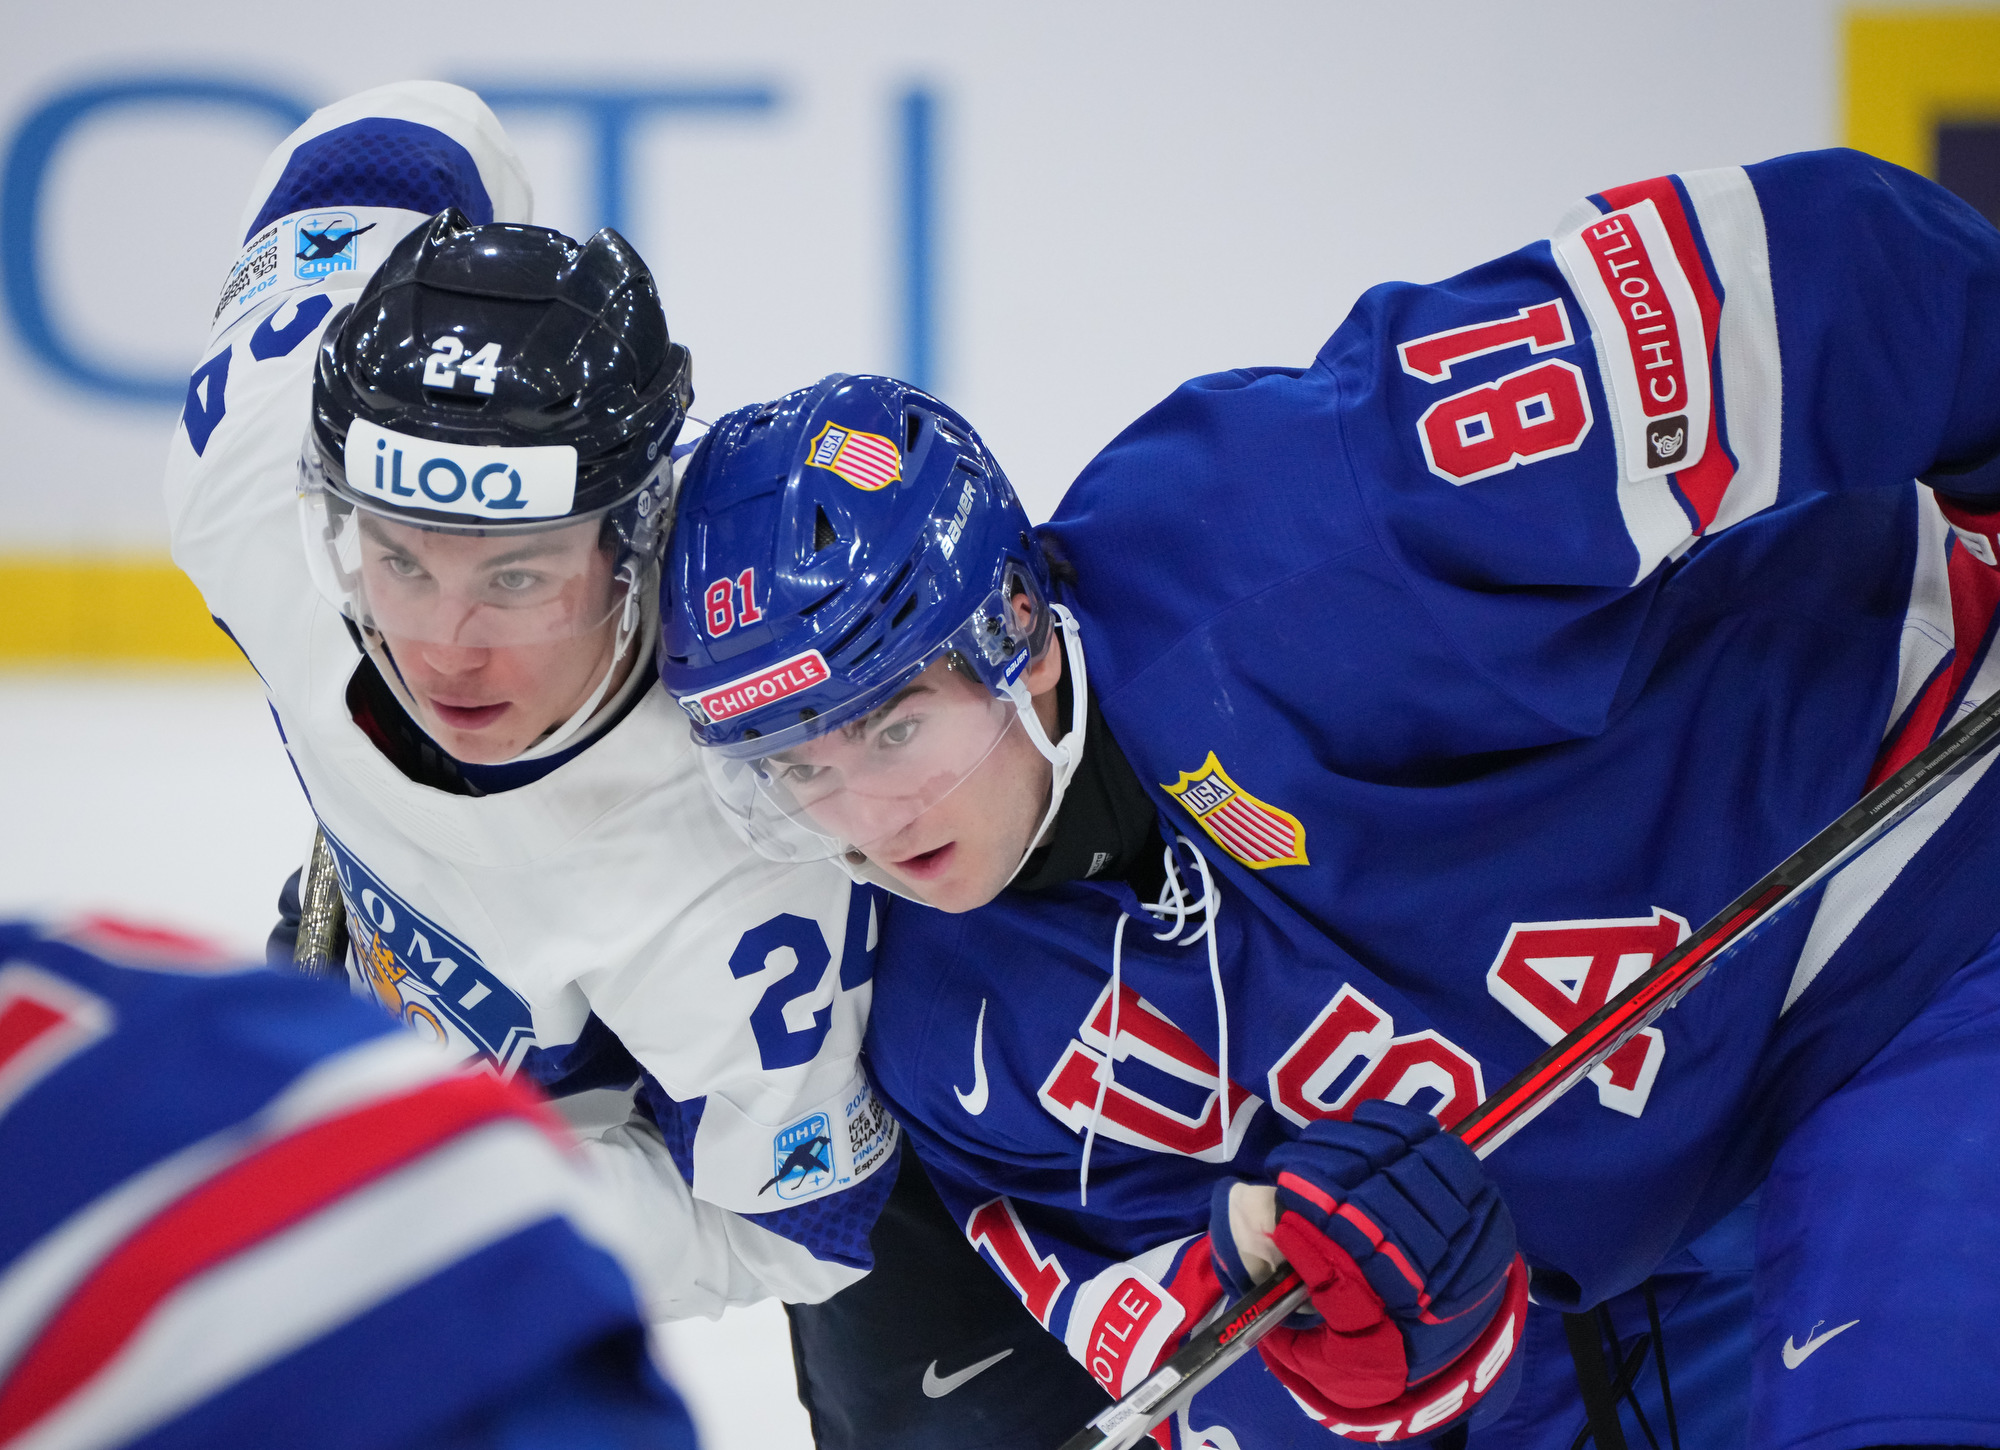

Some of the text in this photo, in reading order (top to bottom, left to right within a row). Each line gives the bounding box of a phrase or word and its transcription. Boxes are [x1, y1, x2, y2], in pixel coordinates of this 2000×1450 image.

[253, 254, 277, 273] U18
[256, 261, 277, 280] ICE
[303, 262, 349, 274] IIHF
[239, 274, 277, 305] 2024
[1592, 218, 1677, 402] CHIPOTLE
[423, 336, 502, 395] 24
[1396, 297, 1594, 487] 81
[818, 433, 842, 459] USA
[375, 438, 529, 510] iLOQ
[940, 479, 977, 561] BAUER
[704, 567, 762, 639] 81
[1005, 648, 1029, 678] BAUER
[708, 661, 819, 716] CHIPOTLE
[1184, 781, 1229, 811] USA
[331, 846, 492, 1010] UOMI
[1037, 905, 1694, 1163] USA
[781, 1120, 823, 1147] IIHF
[848, 1110, 866, 1133] ICE
[850, 1121, 870, 1143] U18
[852, 1119, 888, 1165] FINLAND
[854, 1148, 885, 1176] Espoo
[1094, 1288, 1149, 1390] OTLE
